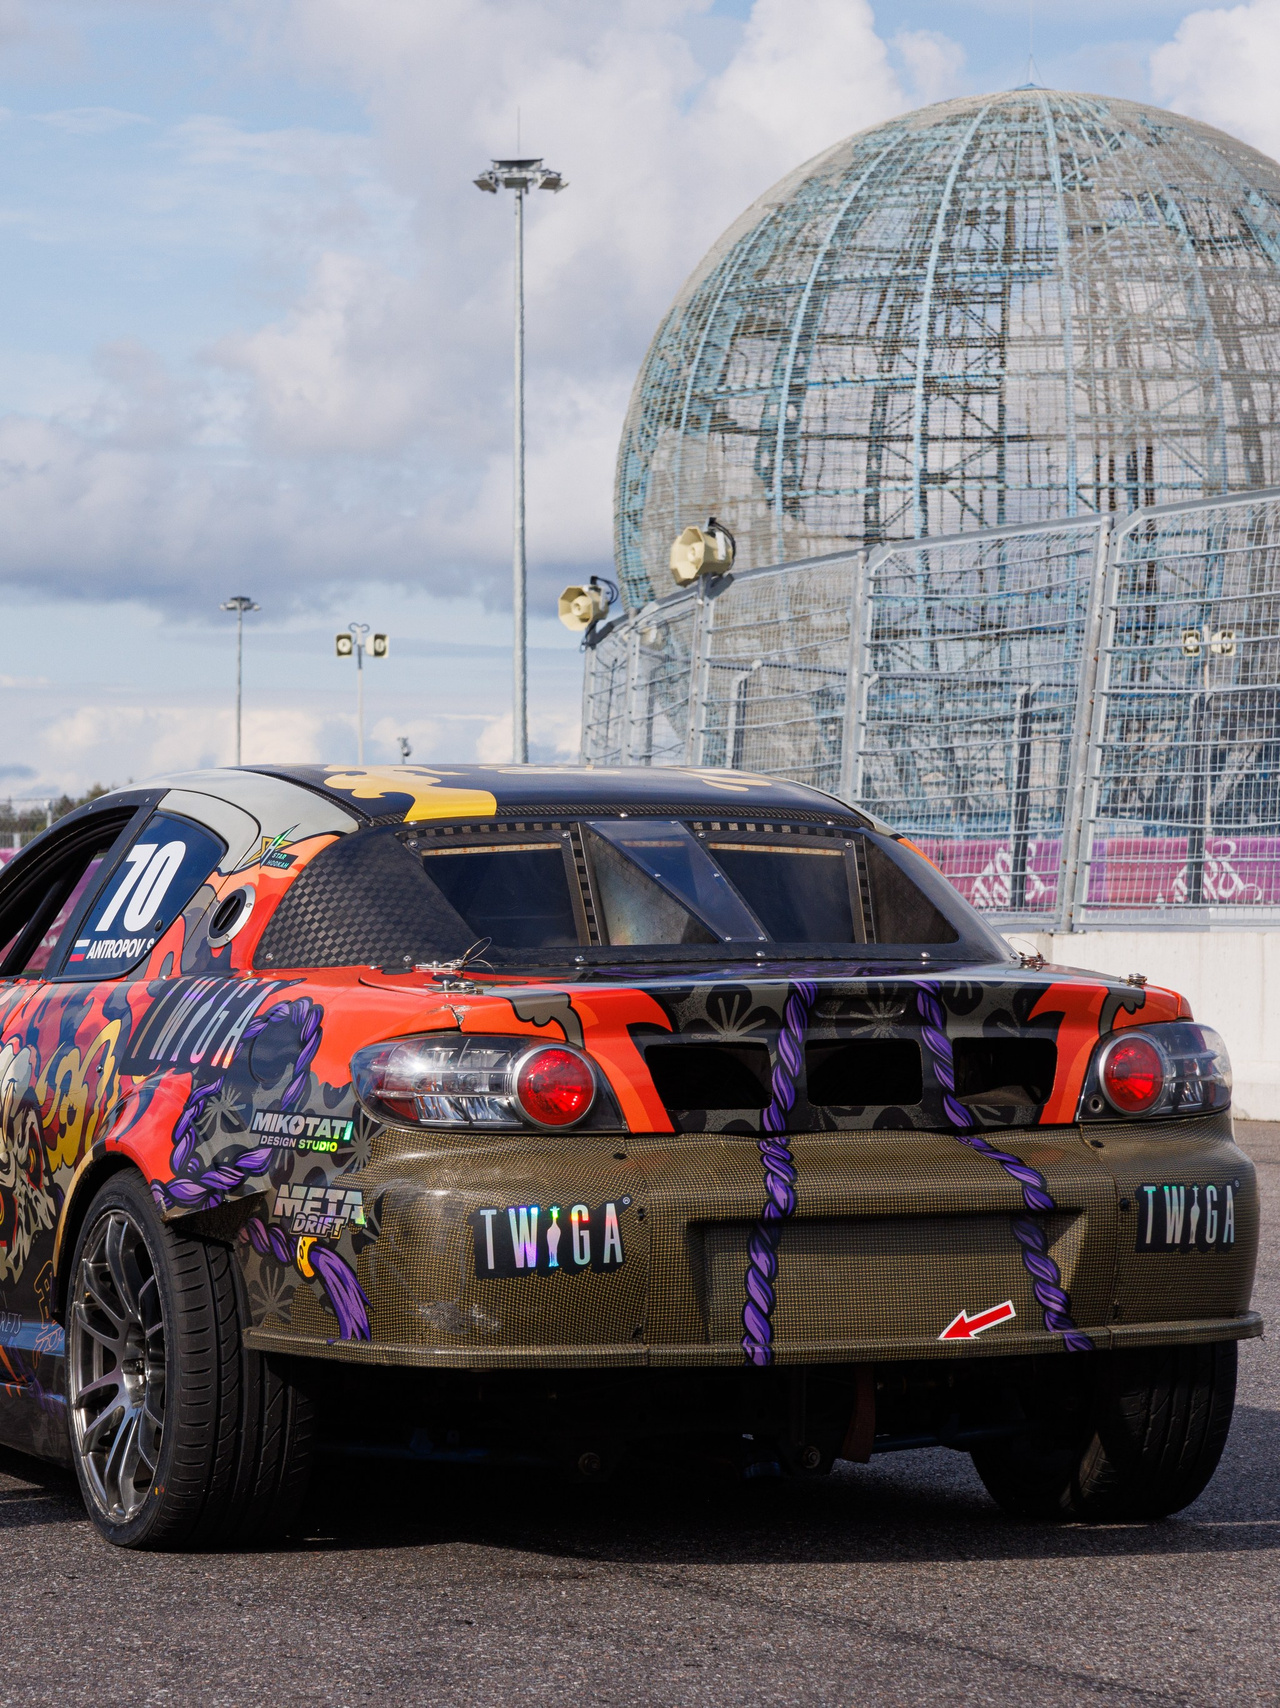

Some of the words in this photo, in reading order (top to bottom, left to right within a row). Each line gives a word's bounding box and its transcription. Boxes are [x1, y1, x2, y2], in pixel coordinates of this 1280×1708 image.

[271, 852, 288, 860] STAR
[95, 841, 186, 931] 70
[86, 938, 147, 959] ANTROPOV
[252, 1112, 354, 1141] MIKOTATI
[260, 1135, 296, 1148] DESIGN
[298, 1139, 338, 1152] STUDIO
[274, 1184, 366, 1225] META
[291, 1213, 346, 1238] DRIFT
